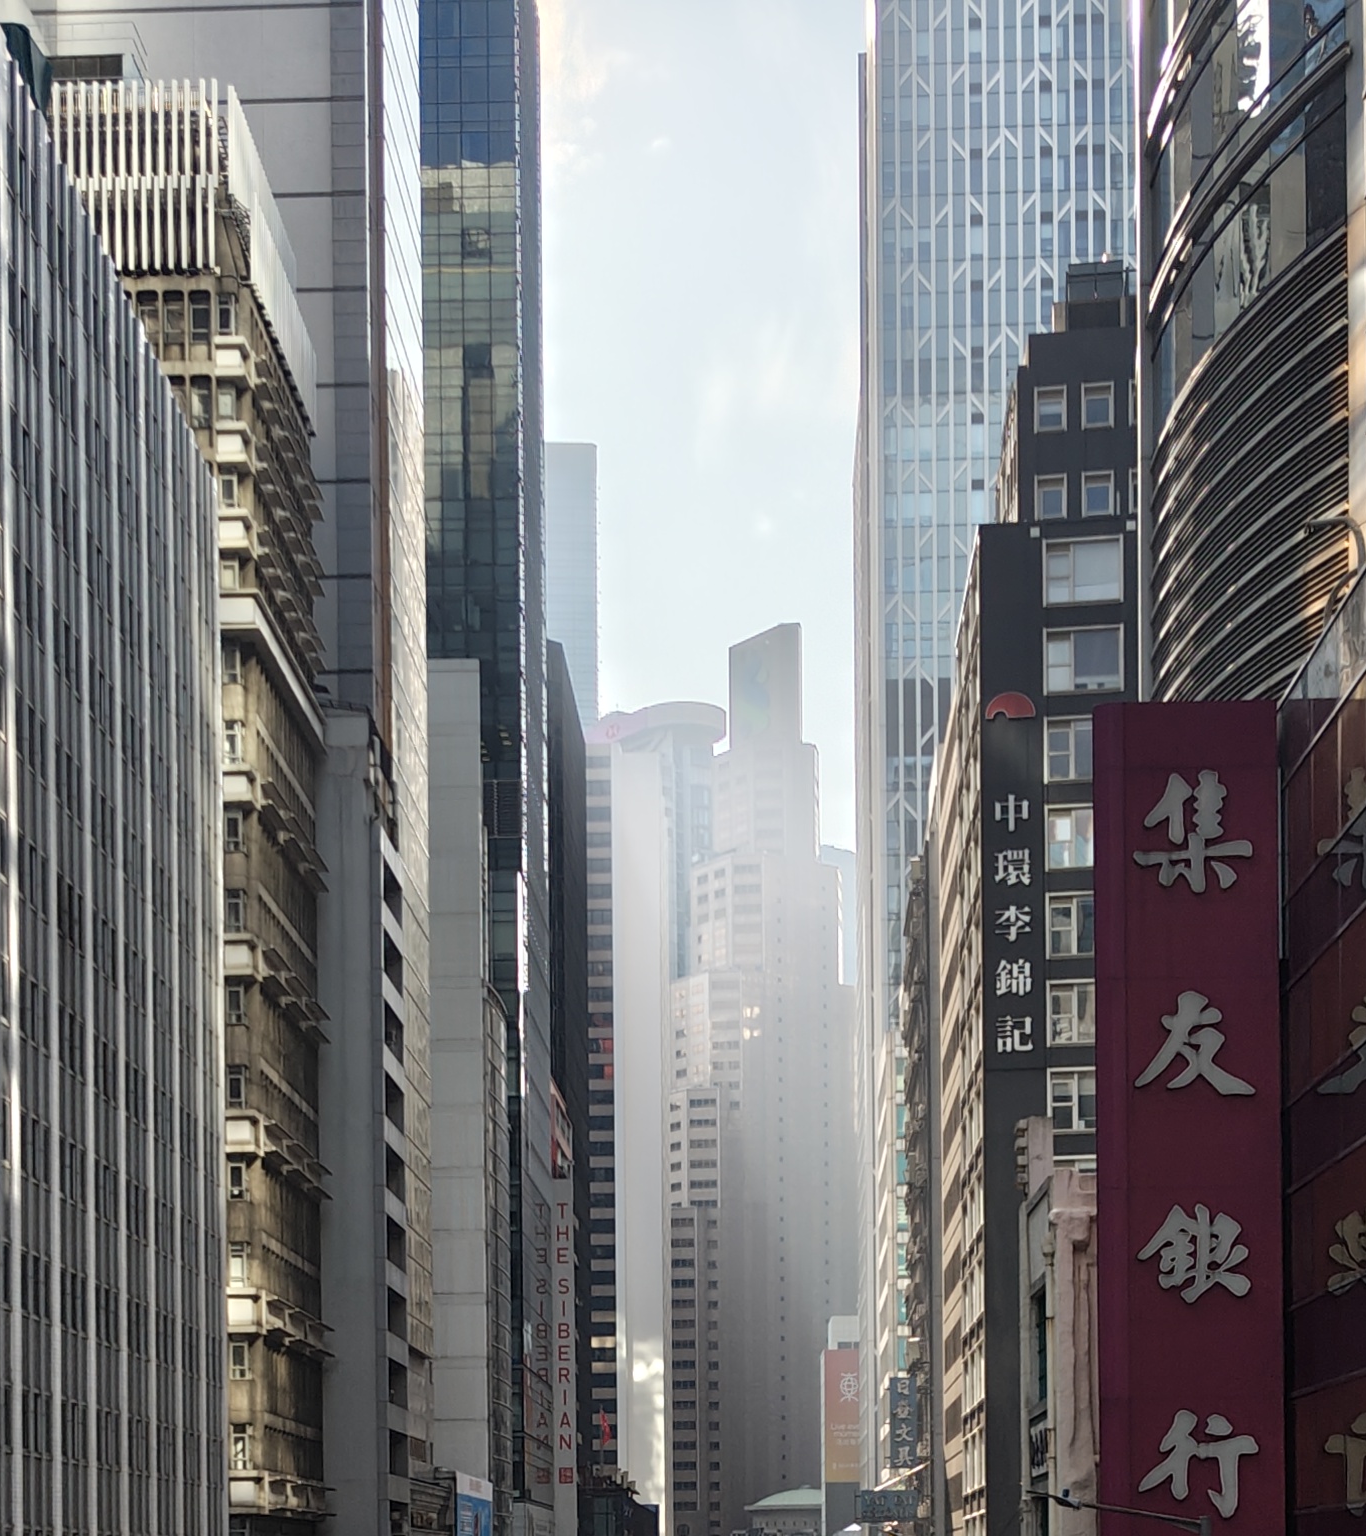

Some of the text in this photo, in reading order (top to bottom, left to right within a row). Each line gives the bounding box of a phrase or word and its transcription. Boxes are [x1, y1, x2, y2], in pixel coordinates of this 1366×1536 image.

[992, 791, 1035, 1055] 中環李錦記
[556, 1202, 570, 1264] THE
[1132, 768, 1260, 1521] 集友銀行
[557, 1278, 572, 1451] SIBERIAN
